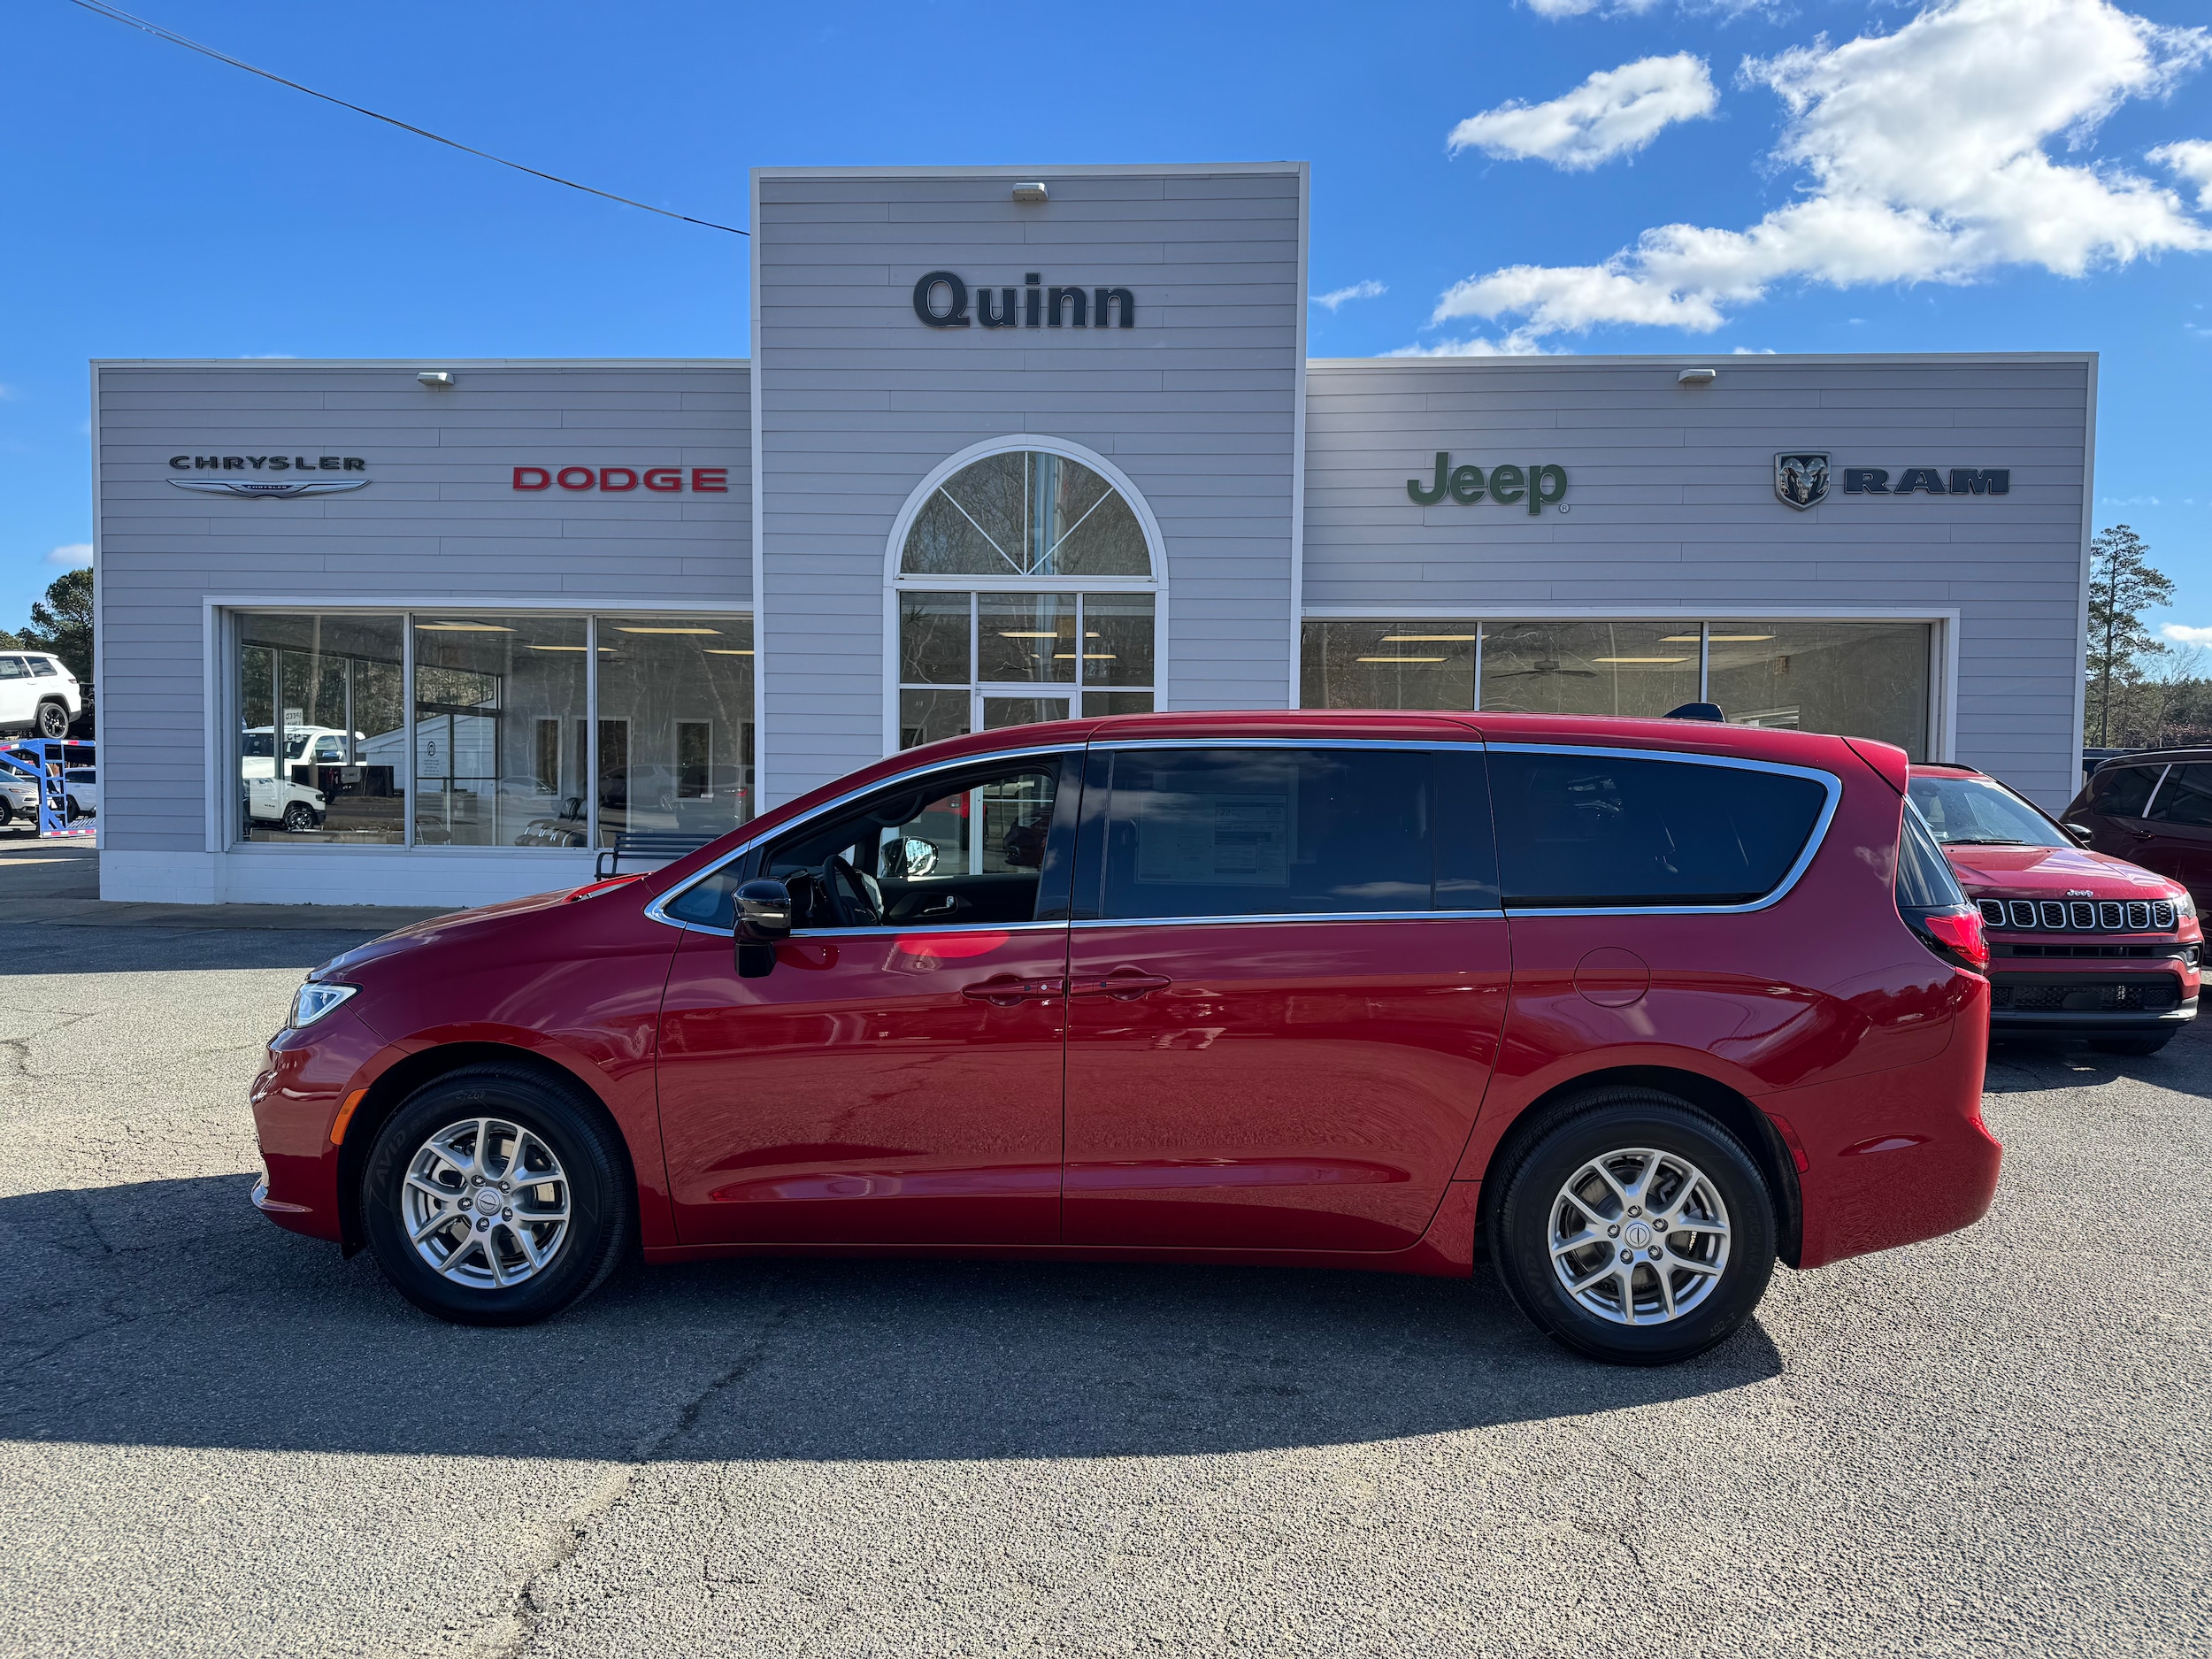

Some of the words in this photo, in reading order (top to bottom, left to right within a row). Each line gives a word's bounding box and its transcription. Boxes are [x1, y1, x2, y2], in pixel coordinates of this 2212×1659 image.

[912, 270, 1135, 328] Quinn
[169, 455, 365, 471] CHRYSLER
[512, 466, 728, 492] DODGE
[1844, 468, 2010, 495] RAM
[1407, 451, 1568, 516] Jeep
[2066, 888, 2093, 897] Jeep
[376, 1131, 407, 1185] AVID
[1744, 1197, 1763, 1275] YOKOHAMA
